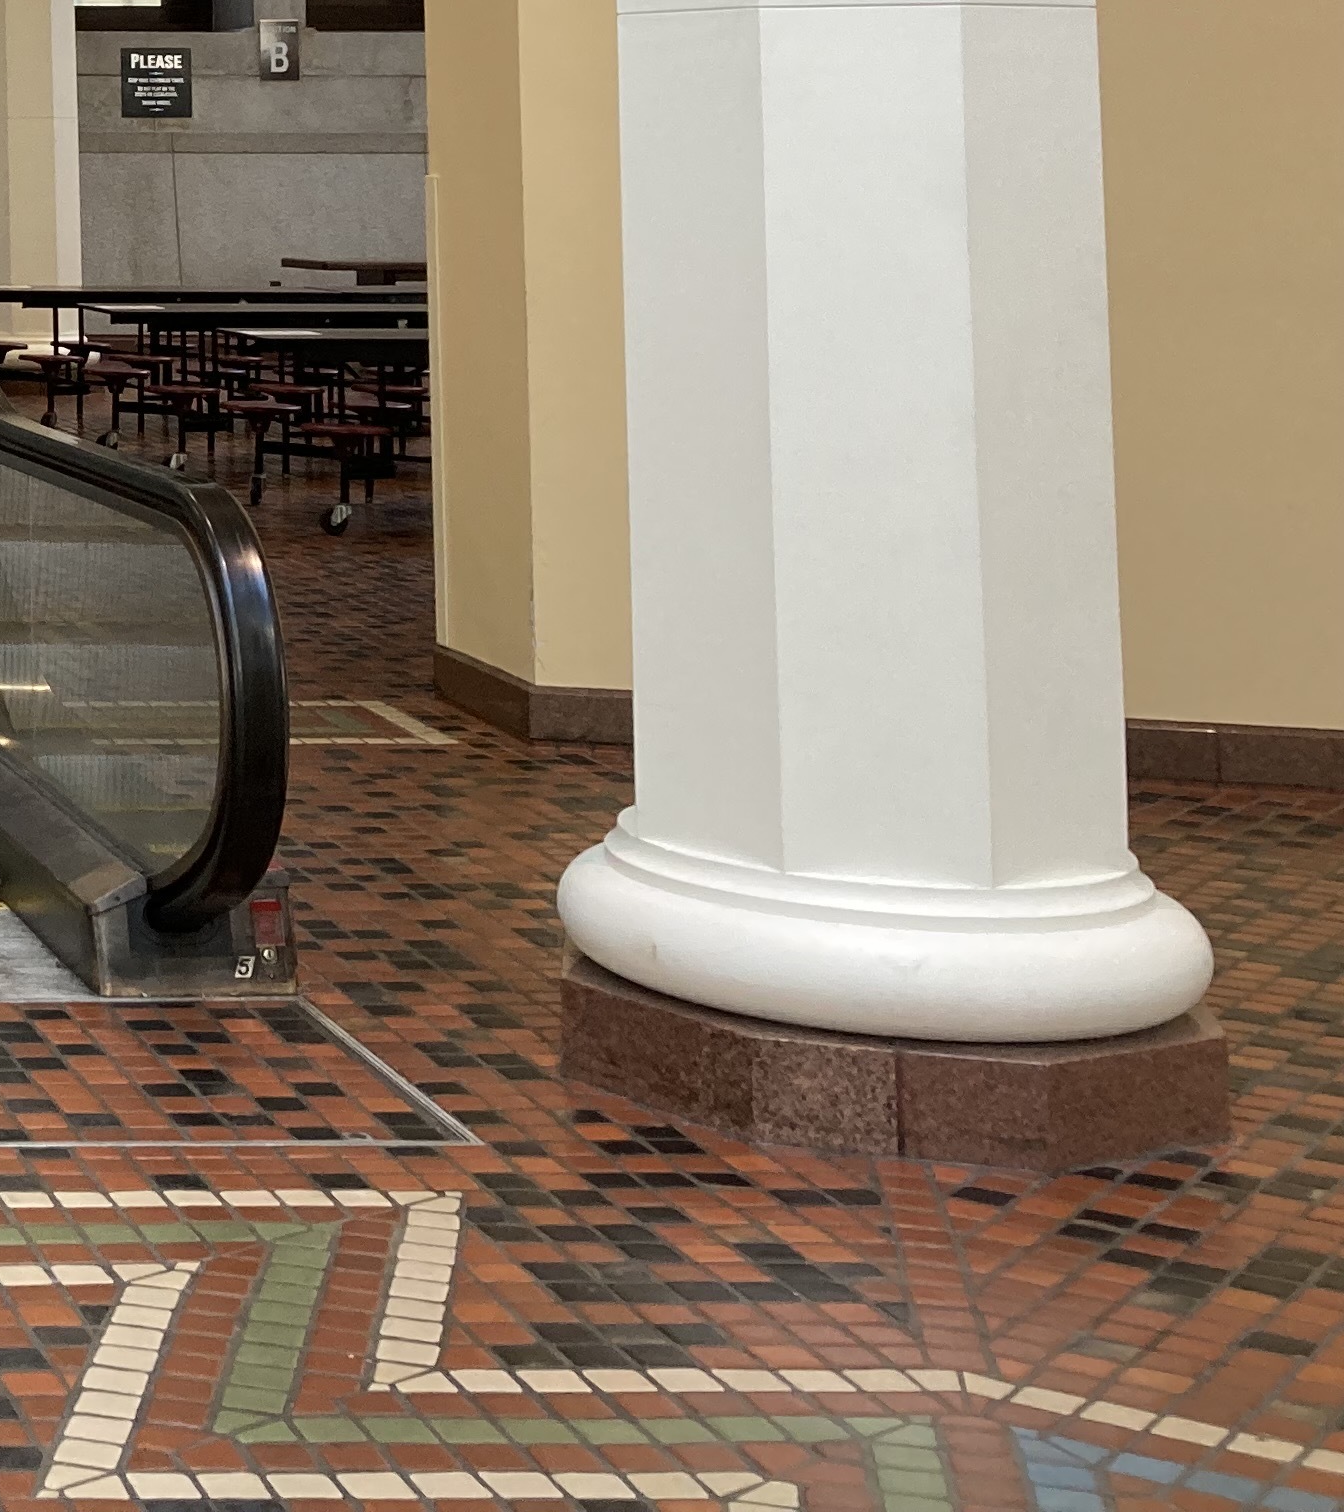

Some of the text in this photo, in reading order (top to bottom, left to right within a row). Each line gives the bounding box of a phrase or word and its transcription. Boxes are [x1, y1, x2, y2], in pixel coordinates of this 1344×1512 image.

[130, 53, 183, 69] PLEASE
[270, 41, 289, 73] B
[237, 958, 252, 975] 5
